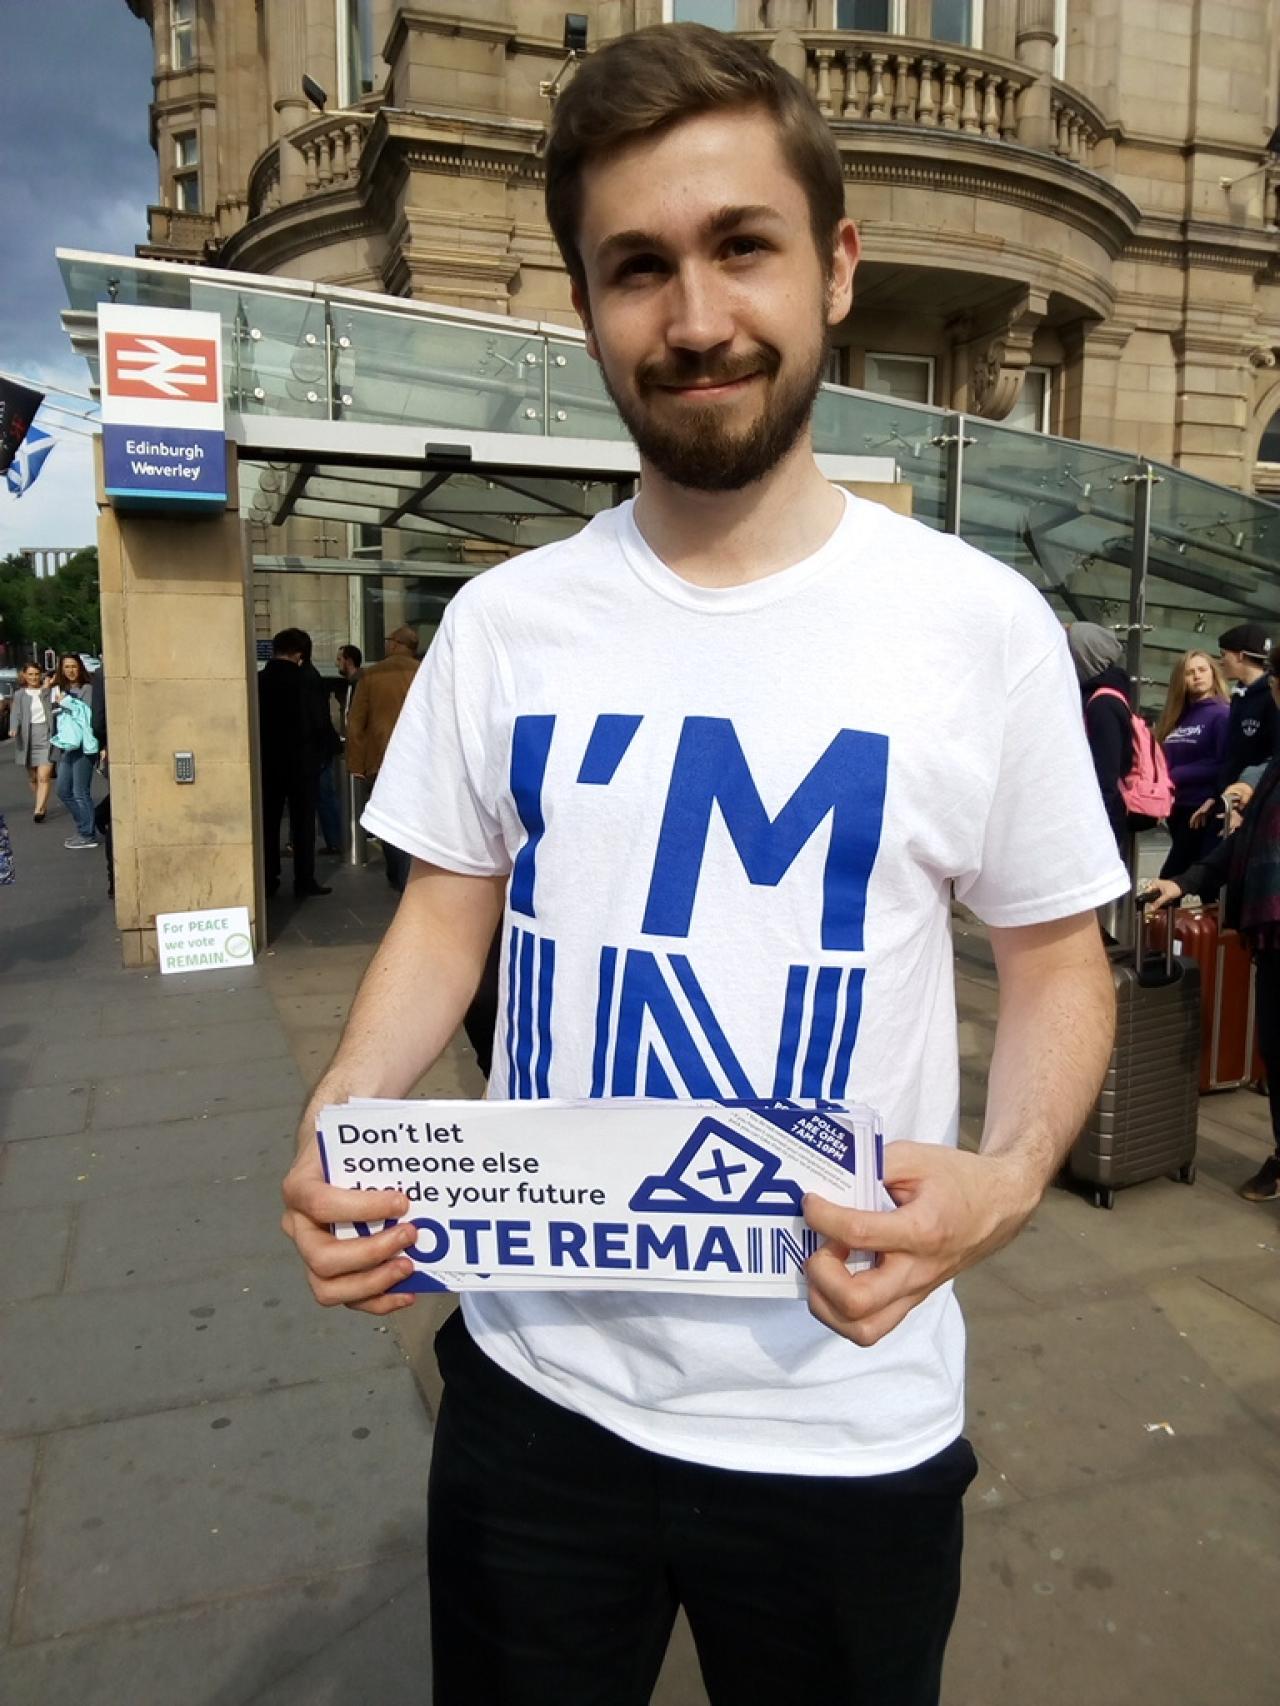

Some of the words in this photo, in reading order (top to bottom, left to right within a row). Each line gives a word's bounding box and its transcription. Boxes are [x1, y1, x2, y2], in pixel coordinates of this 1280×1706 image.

[126, 440, 204, 461] Edinburgh
[131, 461, 200, 480] Waverley
[510, 714, 889, 951] I'M
[163, 923, 184, 934] For
[188, 919, 229, 932] PEACE
[165, 941, 185, 950] we
[187, 937, 216, 948] vote
[507, 926, 867, 1100] IN
[338, 1123, 419, 1144] Don't
[426, 1122, 464, 1144] let
[797, 1118, 820, 1135] ARE
[819, 1130, 849, 1152] OPEN
[811, 1115, 846, 1140] POLLS
[343, 1155, 475, 1173] someone
[482, 1152, 540, 1173] else
[446, 1185, 510, 1207] your
[516, 1183, 606, 1204] future
